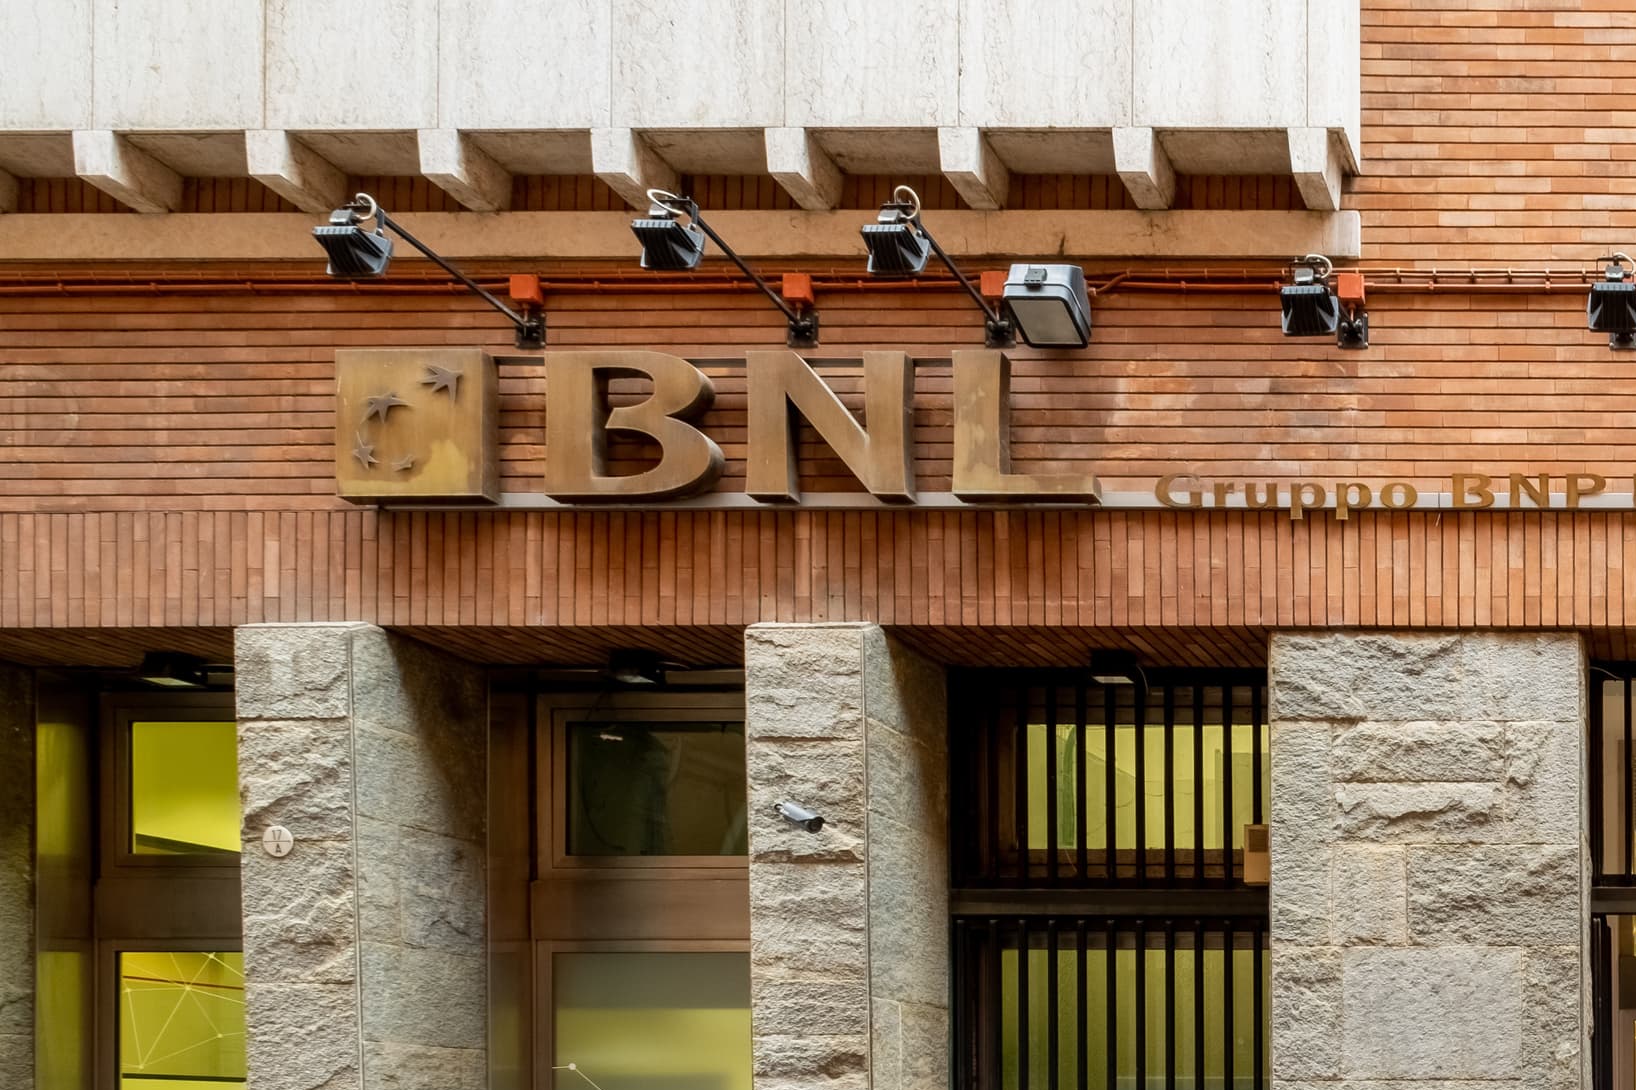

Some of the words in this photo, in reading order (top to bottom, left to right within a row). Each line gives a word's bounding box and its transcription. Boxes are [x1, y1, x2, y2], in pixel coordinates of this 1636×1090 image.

[545, 349, 1103, 504] BNL
[1154, 473, 1419, 520] Gruppo
[1451, 473, 1606, 508] BNP
[275, 843, 282, 853] A
